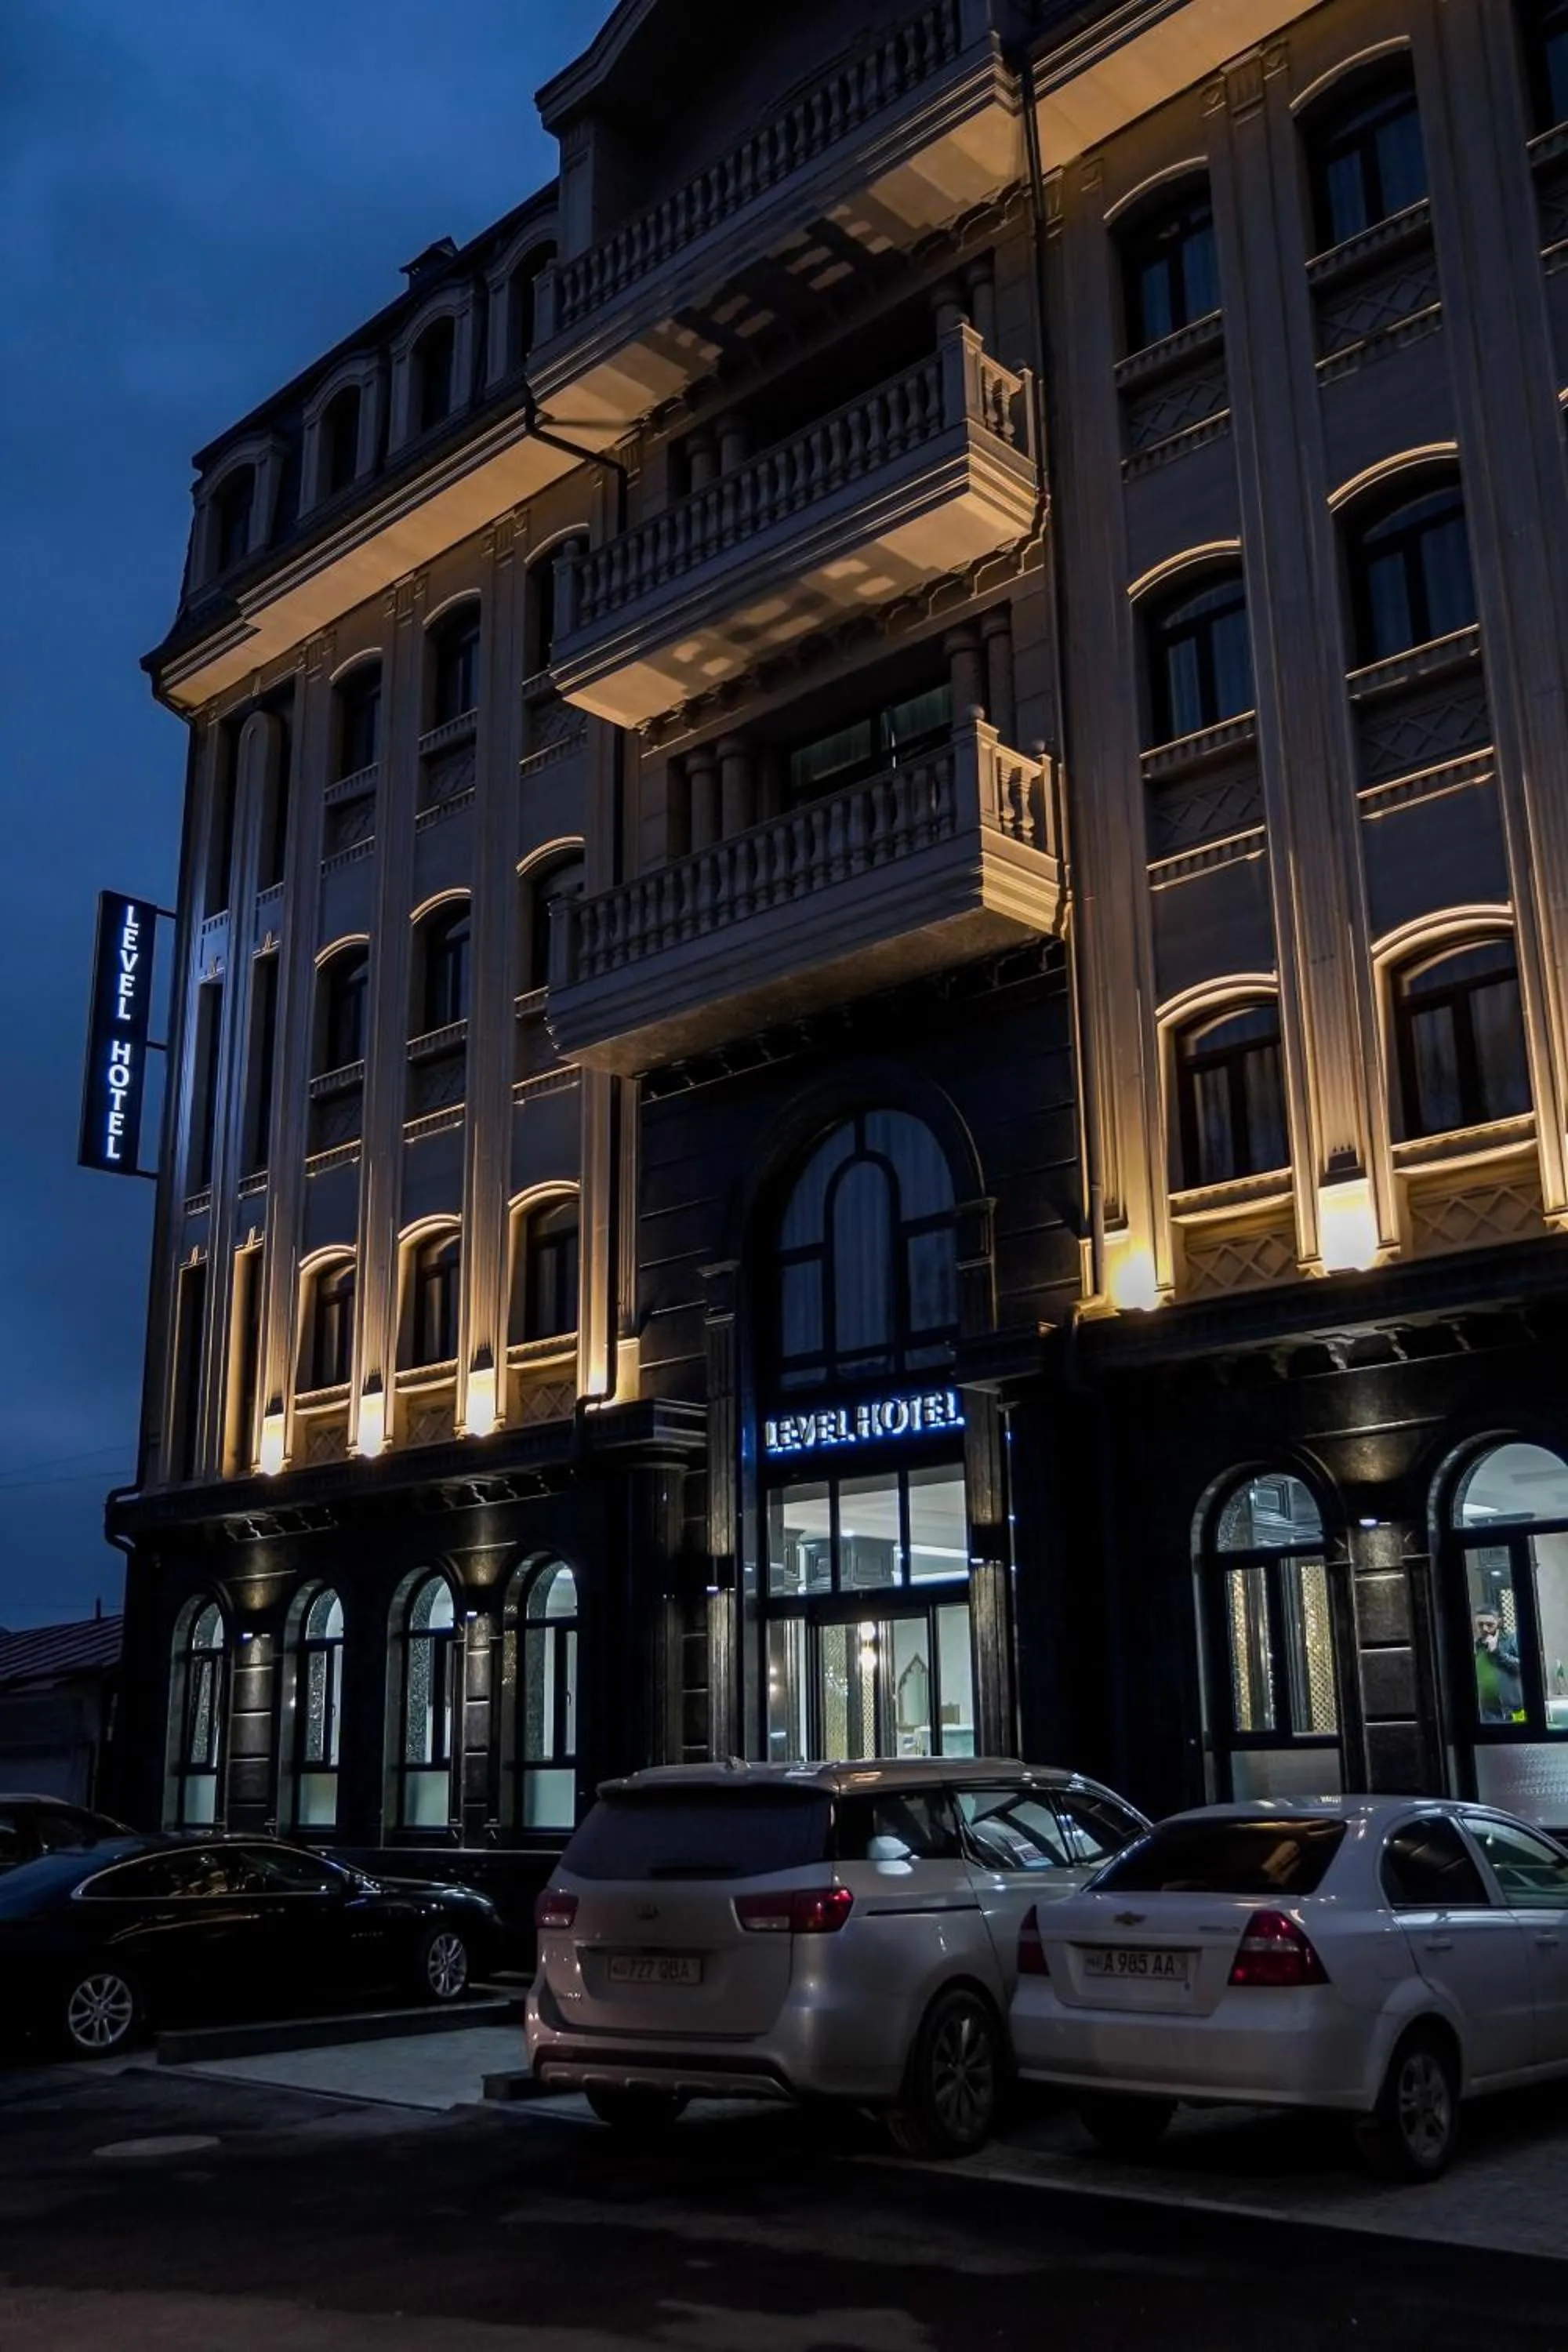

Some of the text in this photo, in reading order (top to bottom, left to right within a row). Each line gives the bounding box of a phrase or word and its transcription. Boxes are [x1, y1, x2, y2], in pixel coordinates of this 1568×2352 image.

[106, 905, 140, 1159] LEVEL HOTEL
[764, 1391, 965, 1453] LEVEL HOTEL
